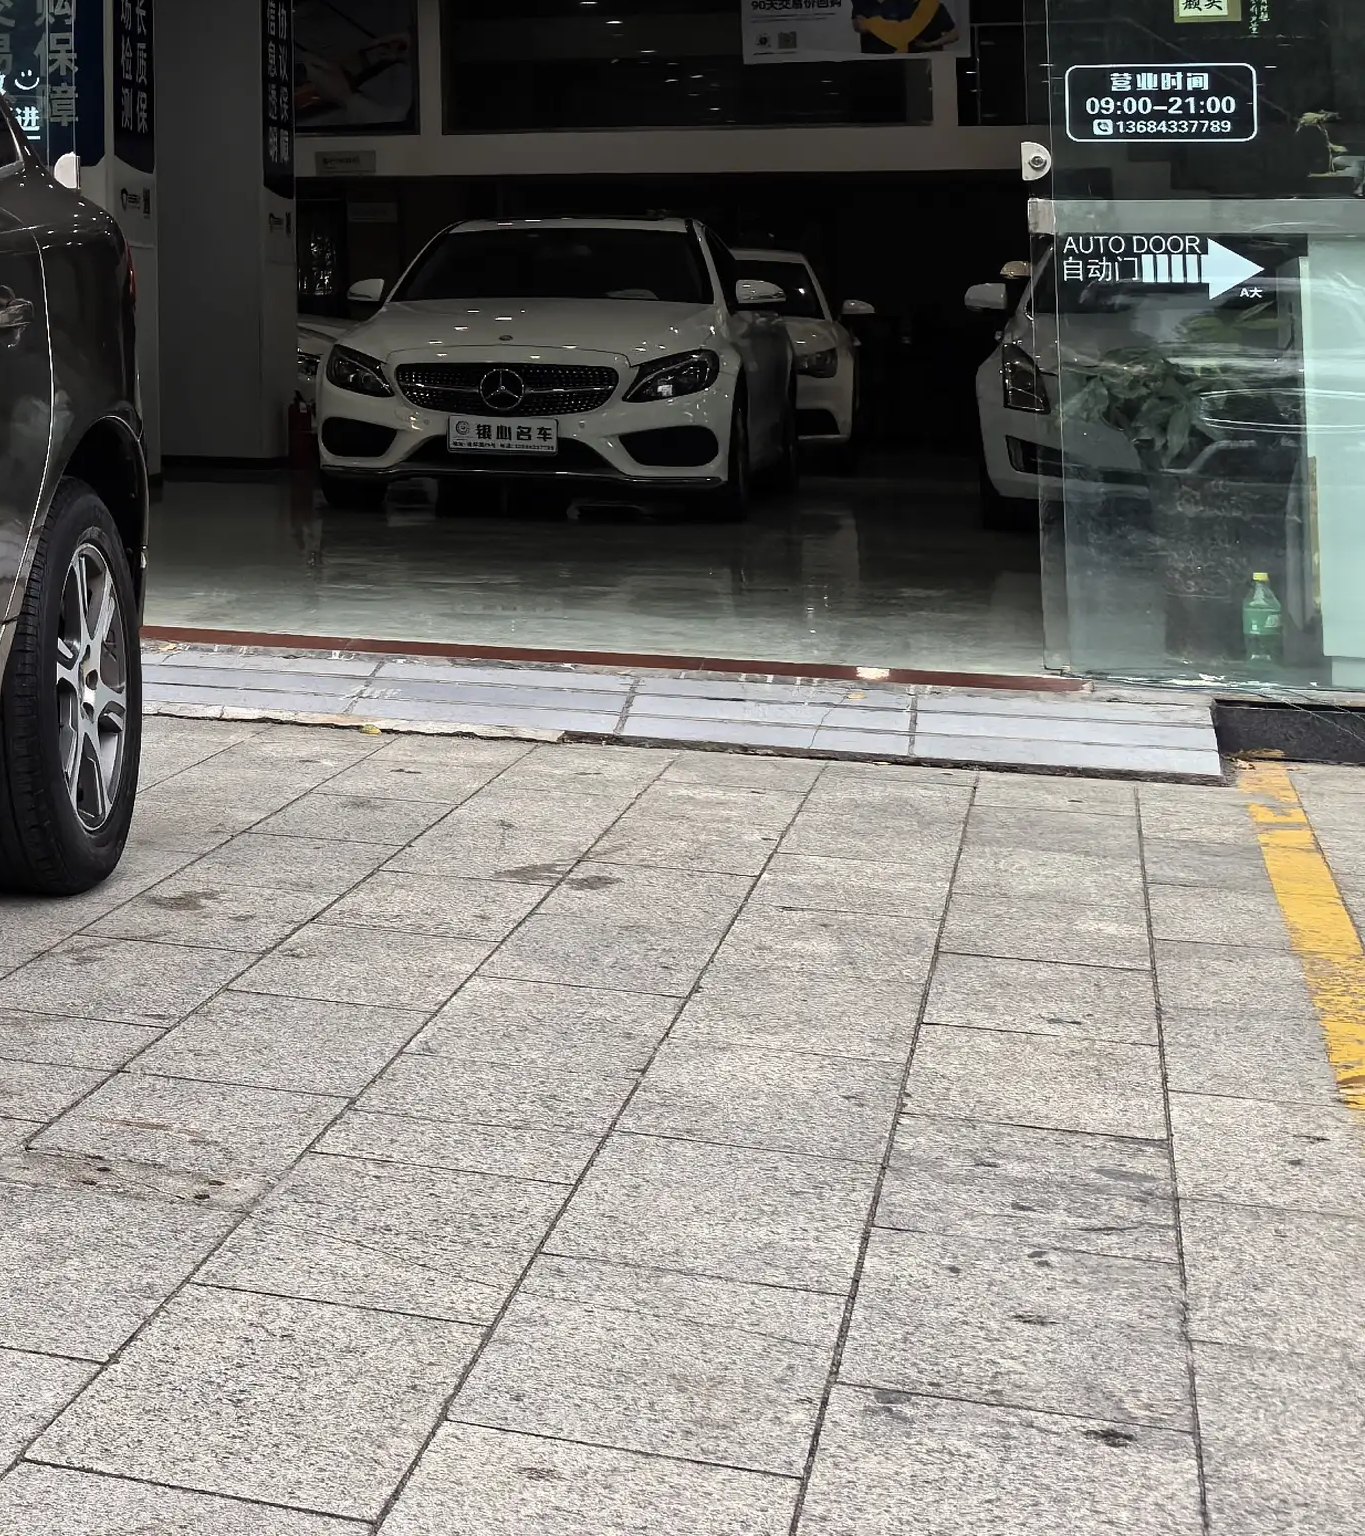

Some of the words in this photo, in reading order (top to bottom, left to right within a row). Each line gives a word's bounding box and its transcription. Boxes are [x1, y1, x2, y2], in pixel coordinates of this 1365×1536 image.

[1110, 72, 1209, 92] 营业时间
[1116, 120, 1232, 134] 13684337789
[1063, 236, 1126, 254] AUTO
[1133, 235, 1202, 254] DOOR
[1063, 256, 1139, 282] 自动门
[475, 423, 553, 443] 银心名车
